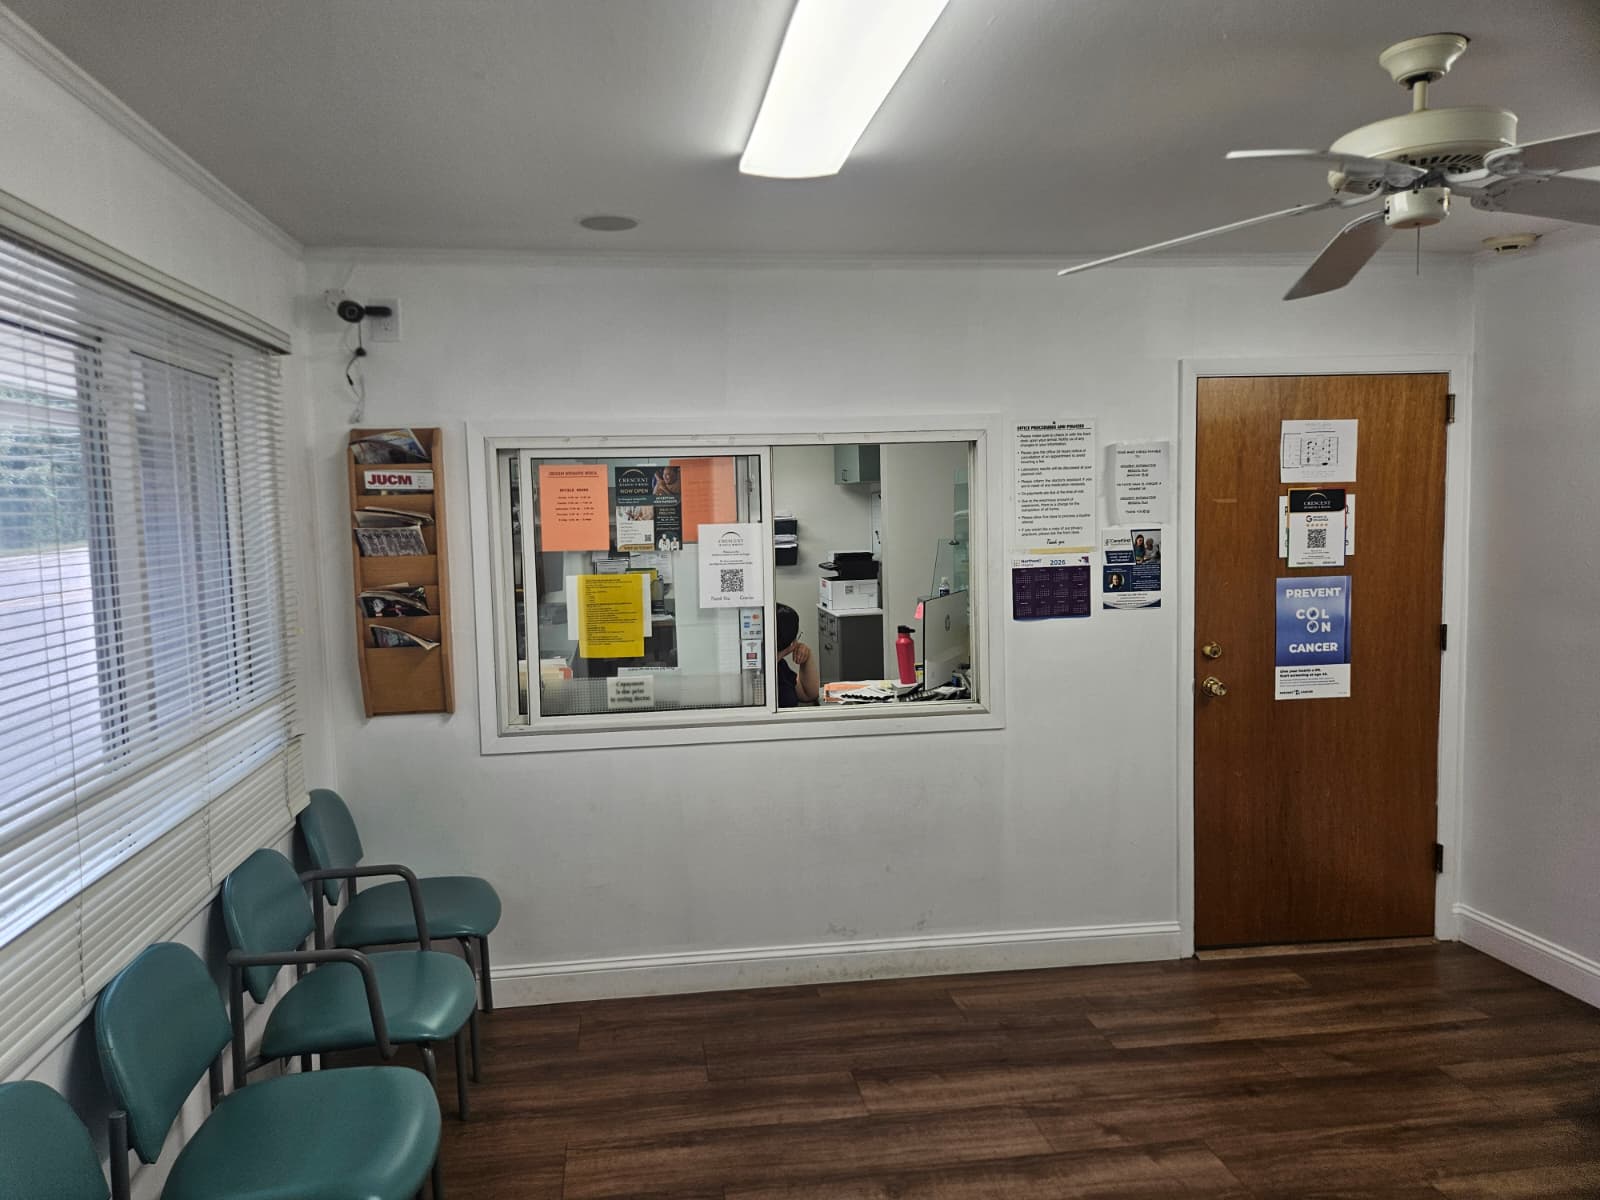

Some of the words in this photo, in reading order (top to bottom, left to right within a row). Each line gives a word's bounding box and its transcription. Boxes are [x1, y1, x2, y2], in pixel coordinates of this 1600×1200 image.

[367, 474, 412, 486] JUCM
[1049, 559, 1067, 567] 2026
[1285, 586, 1342, 600] PREVENT
[1288, 641, 1340, 655] CANCER
